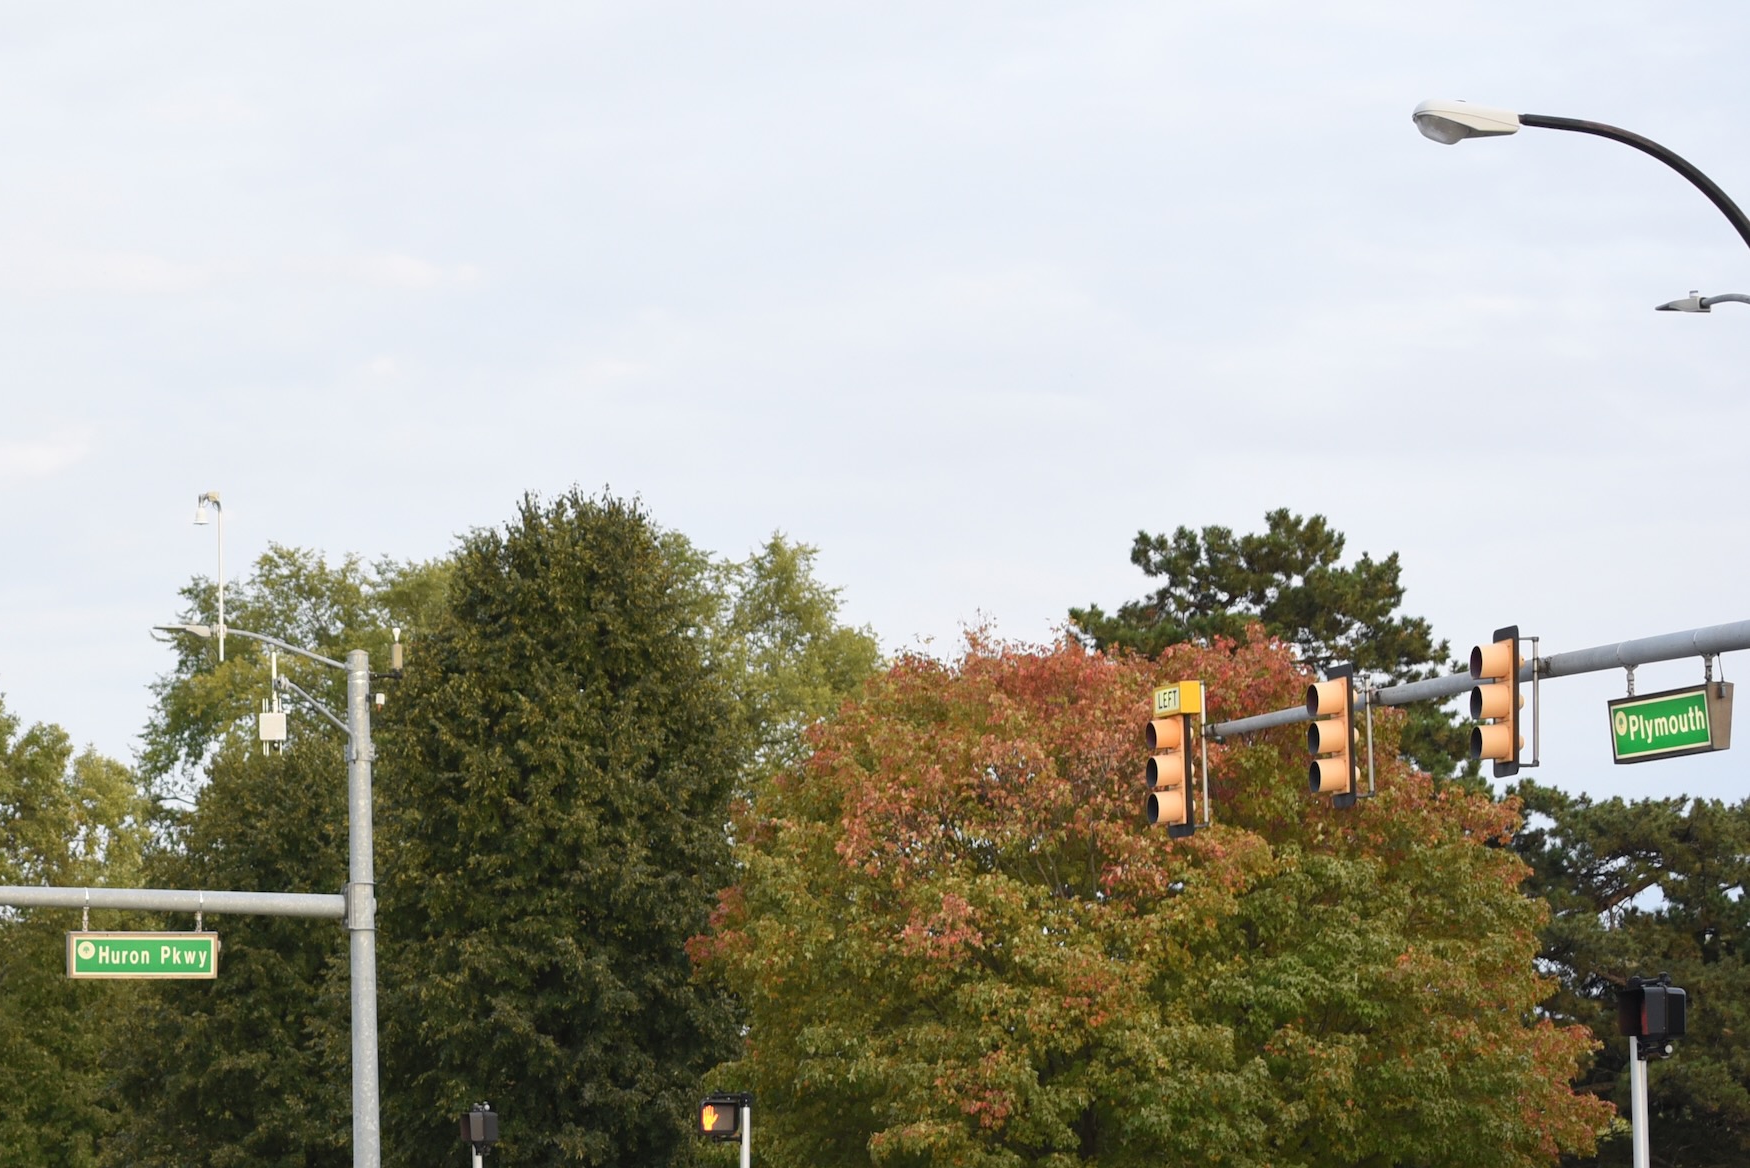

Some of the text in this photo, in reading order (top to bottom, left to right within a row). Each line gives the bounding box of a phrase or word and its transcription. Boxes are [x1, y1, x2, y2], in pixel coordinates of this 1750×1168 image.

[1158, 690, 1177, 709] LEFT
[1629, 705, 1706, 744] Plymouth
[98, 945, 207, 968] Huron Pkwy
